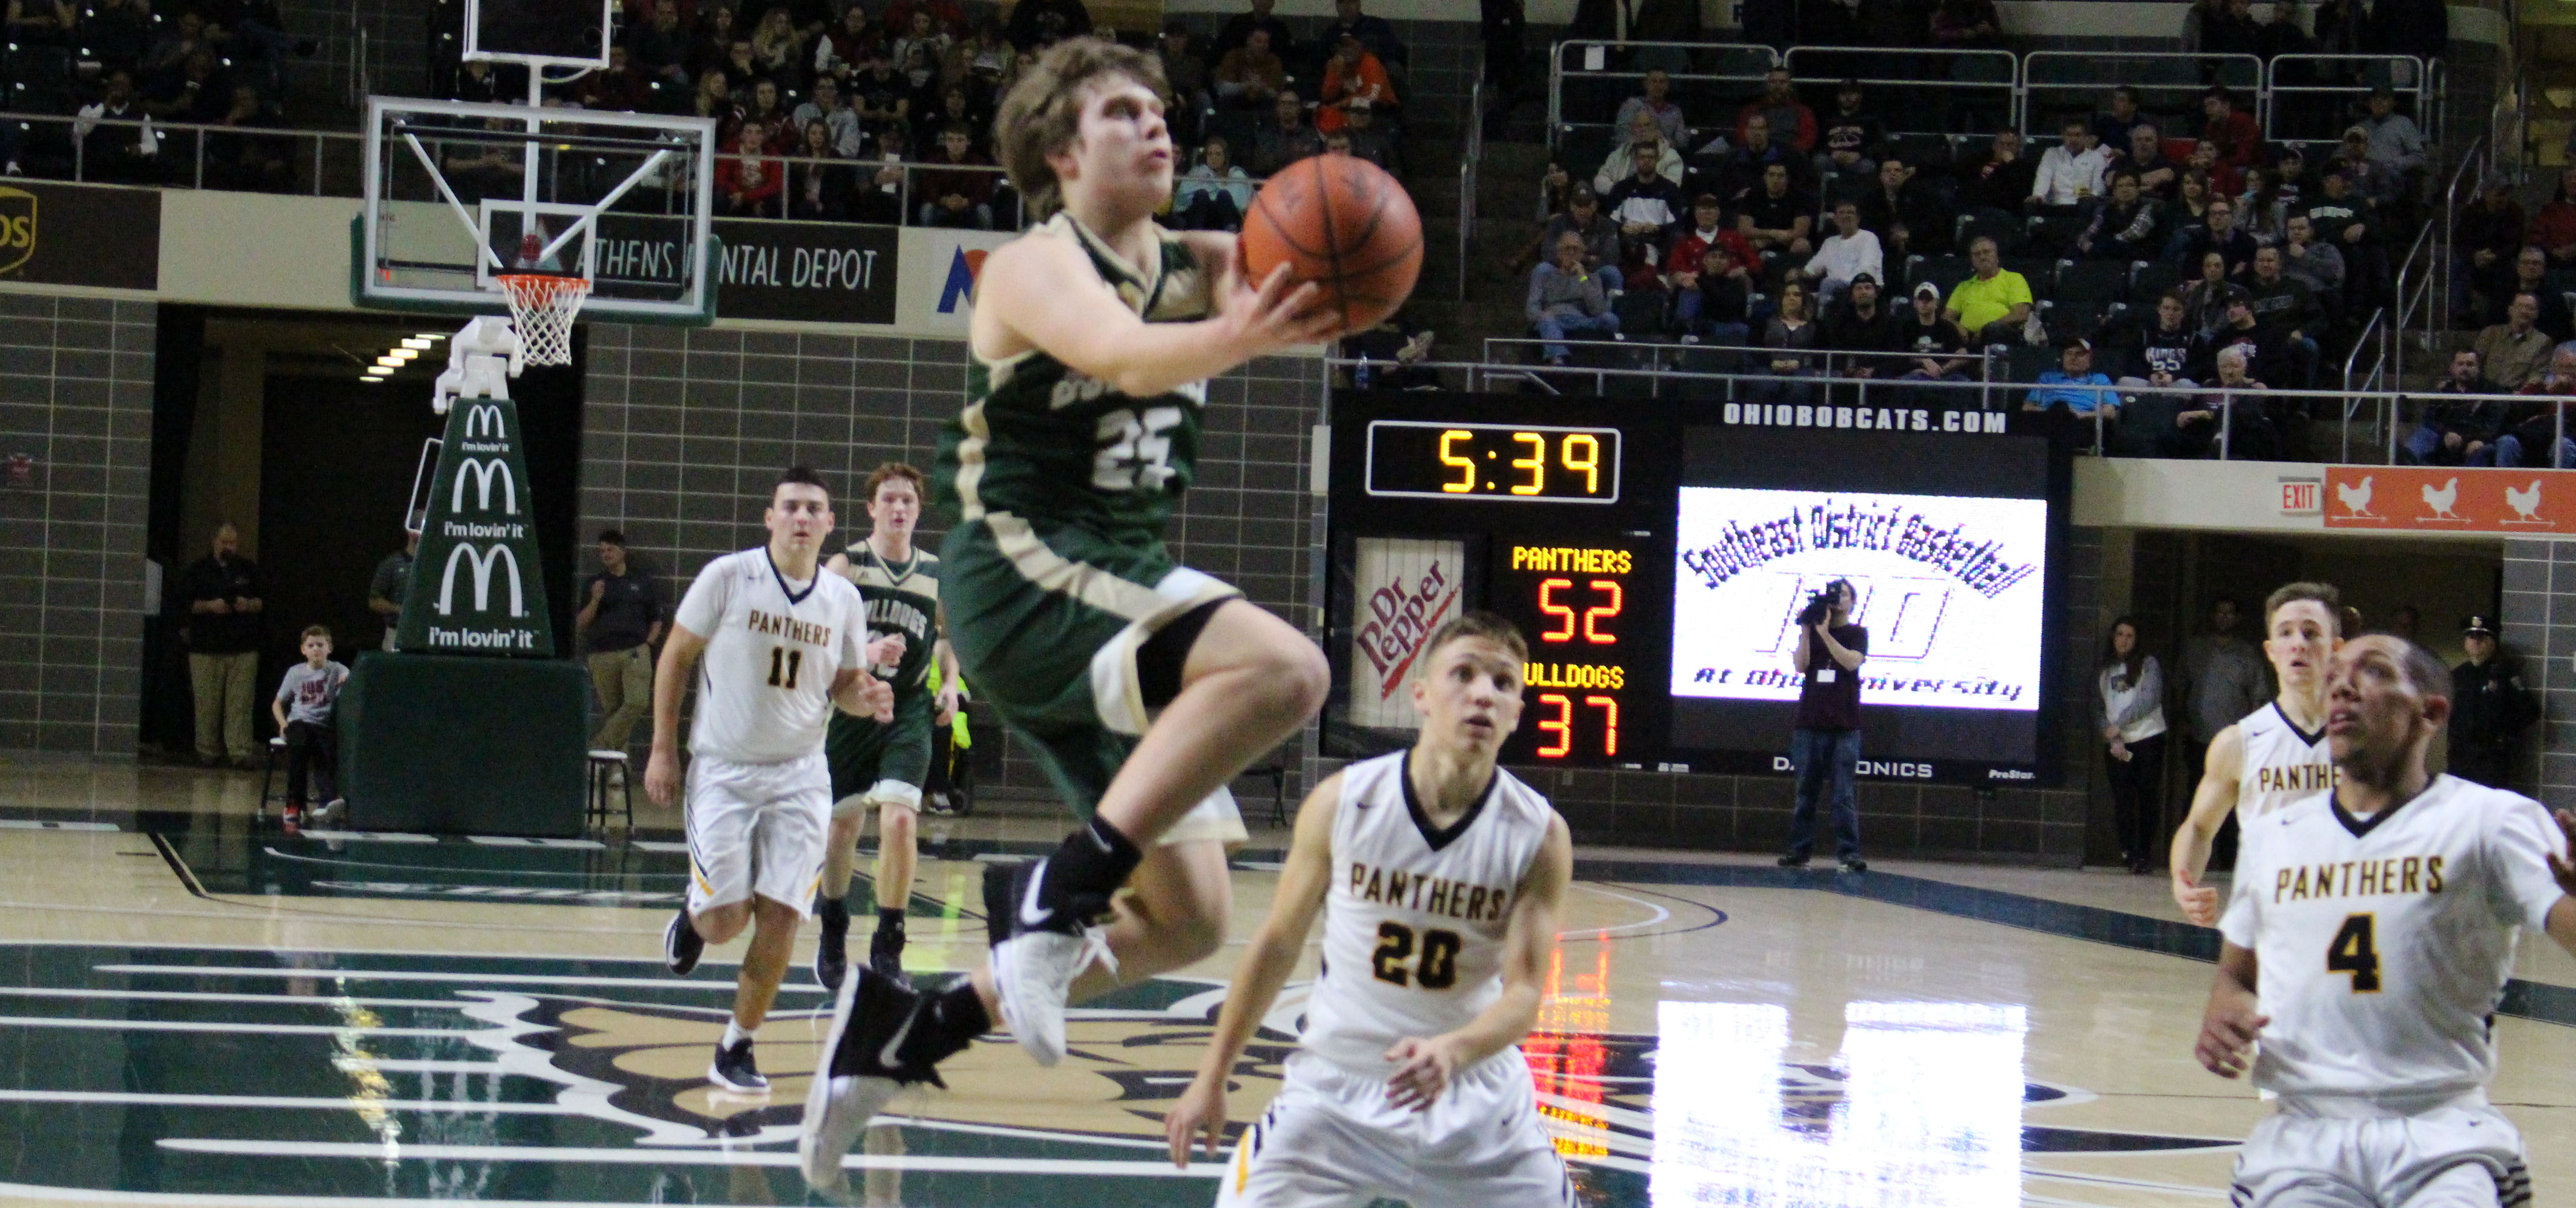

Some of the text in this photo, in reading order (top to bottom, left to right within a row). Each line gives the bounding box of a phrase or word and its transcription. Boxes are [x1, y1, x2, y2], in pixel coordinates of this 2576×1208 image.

[792, 248, 877, 290] DEPOT
[1723, 403, 2006, 433] OHIOBOBCATS.COM
[1440, 430, 1599, 495] 5:39
[2283, 484, 2315, 510] EXIT
[512, 523, 524, 538] it
[1512, 545, 1632, 574] PANTHERS
[863, 598, 928, 641] ULLDOGS
[1356, 559, 1445, 678] Pepper
[1369, 575, 1407, 628] Dr
[1538, 578, 1623, 644] 52
[518, 629, 533, 649] it
[748, 609, 831, 647] PANTHERS
[768, 646, 802, 689] 11
[1523, 662, 1624, 689] ULLDOGS
[1859, 673, 2023, 702] niversity
[1536, 693, 1619, 757] 37
[1773, 756, 1933, 778] DONICS
[2259, 763, 2342, 792] PANTHE
[1351, 862, 1507, 921] PANTHERS
[2274, 855, 2446, 904] PANTHERS
[1371, 920, 1464, 990] 20
[2327, 911, 2382, 994] 4
